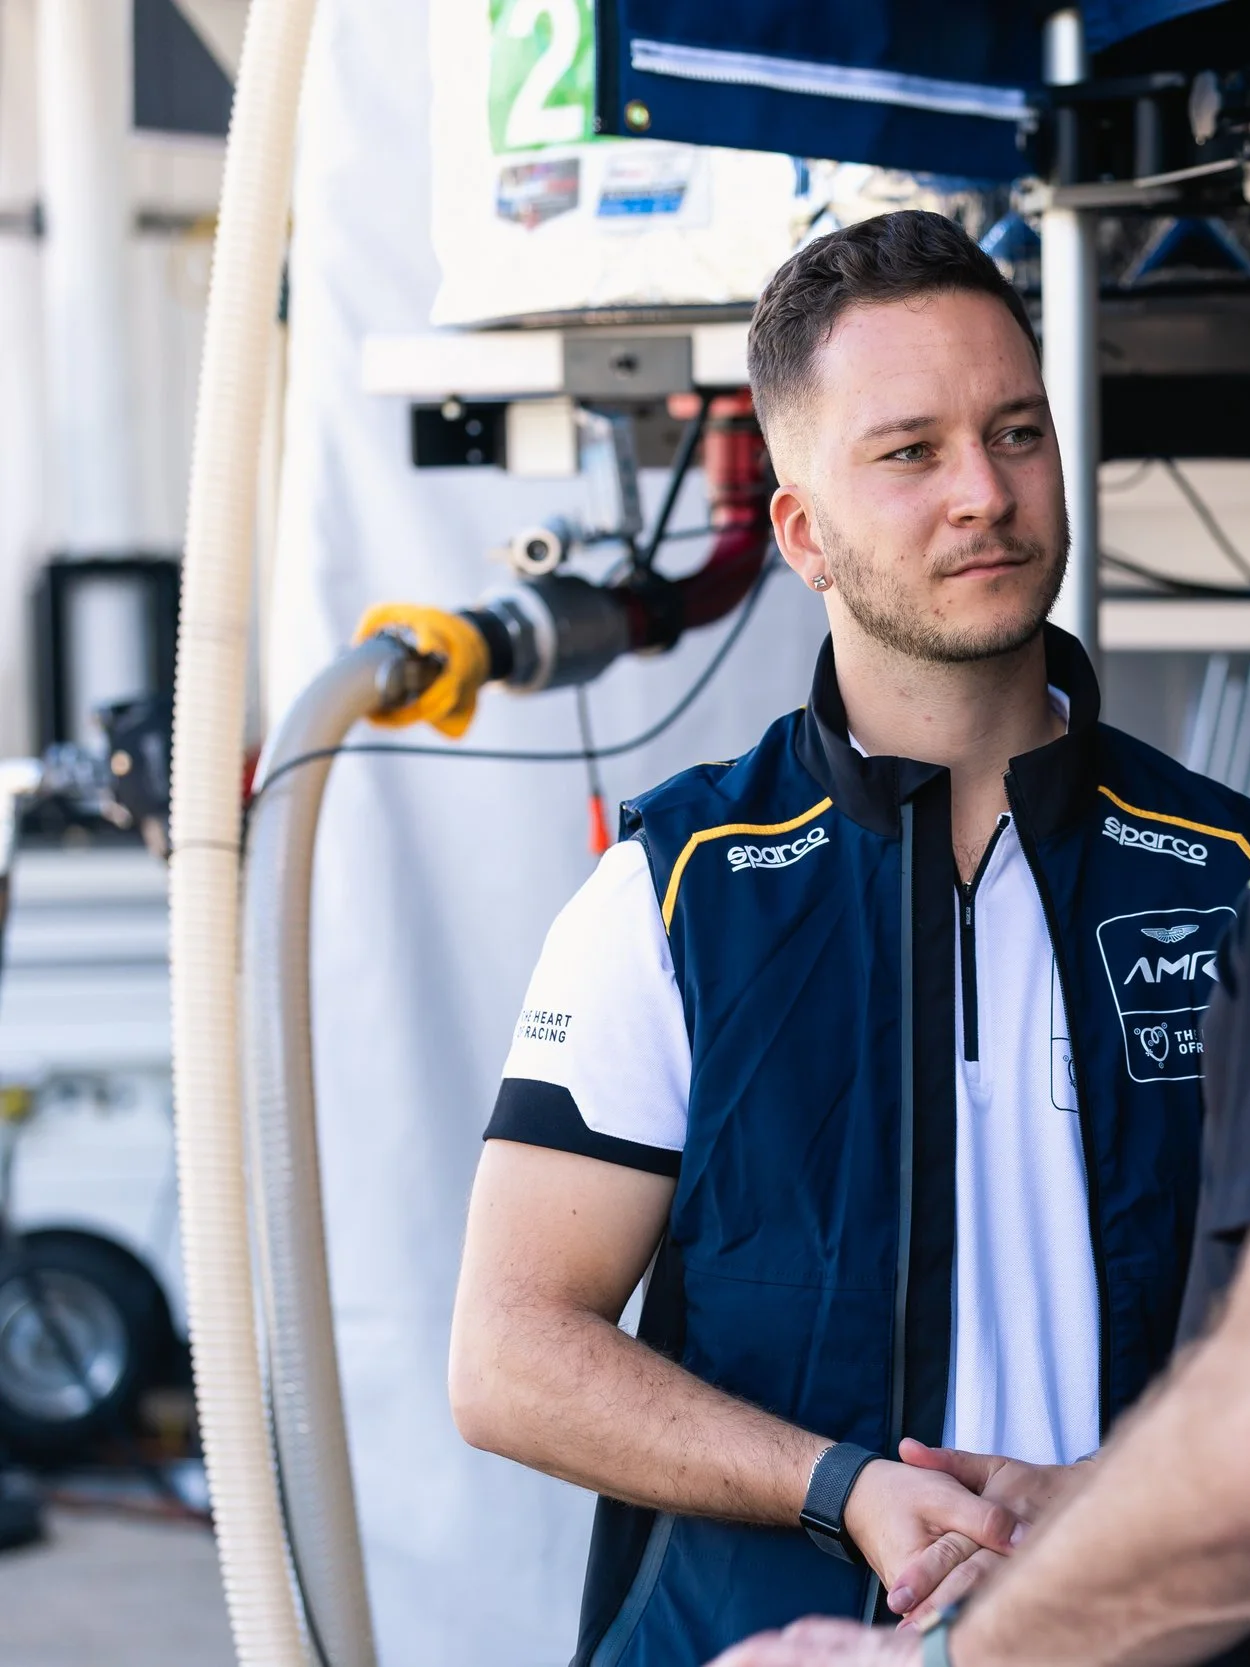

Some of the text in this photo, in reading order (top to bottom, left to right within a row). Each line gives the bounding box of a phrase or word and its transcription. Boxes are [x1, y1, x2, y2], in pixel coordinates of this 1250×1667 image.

[727, 827, 825, 869] sparco
[1104, 816, 1208, 862] sparco
[533, 1010, 572, 1027] HEART
[524, 1026, 566, 1043] RACING
